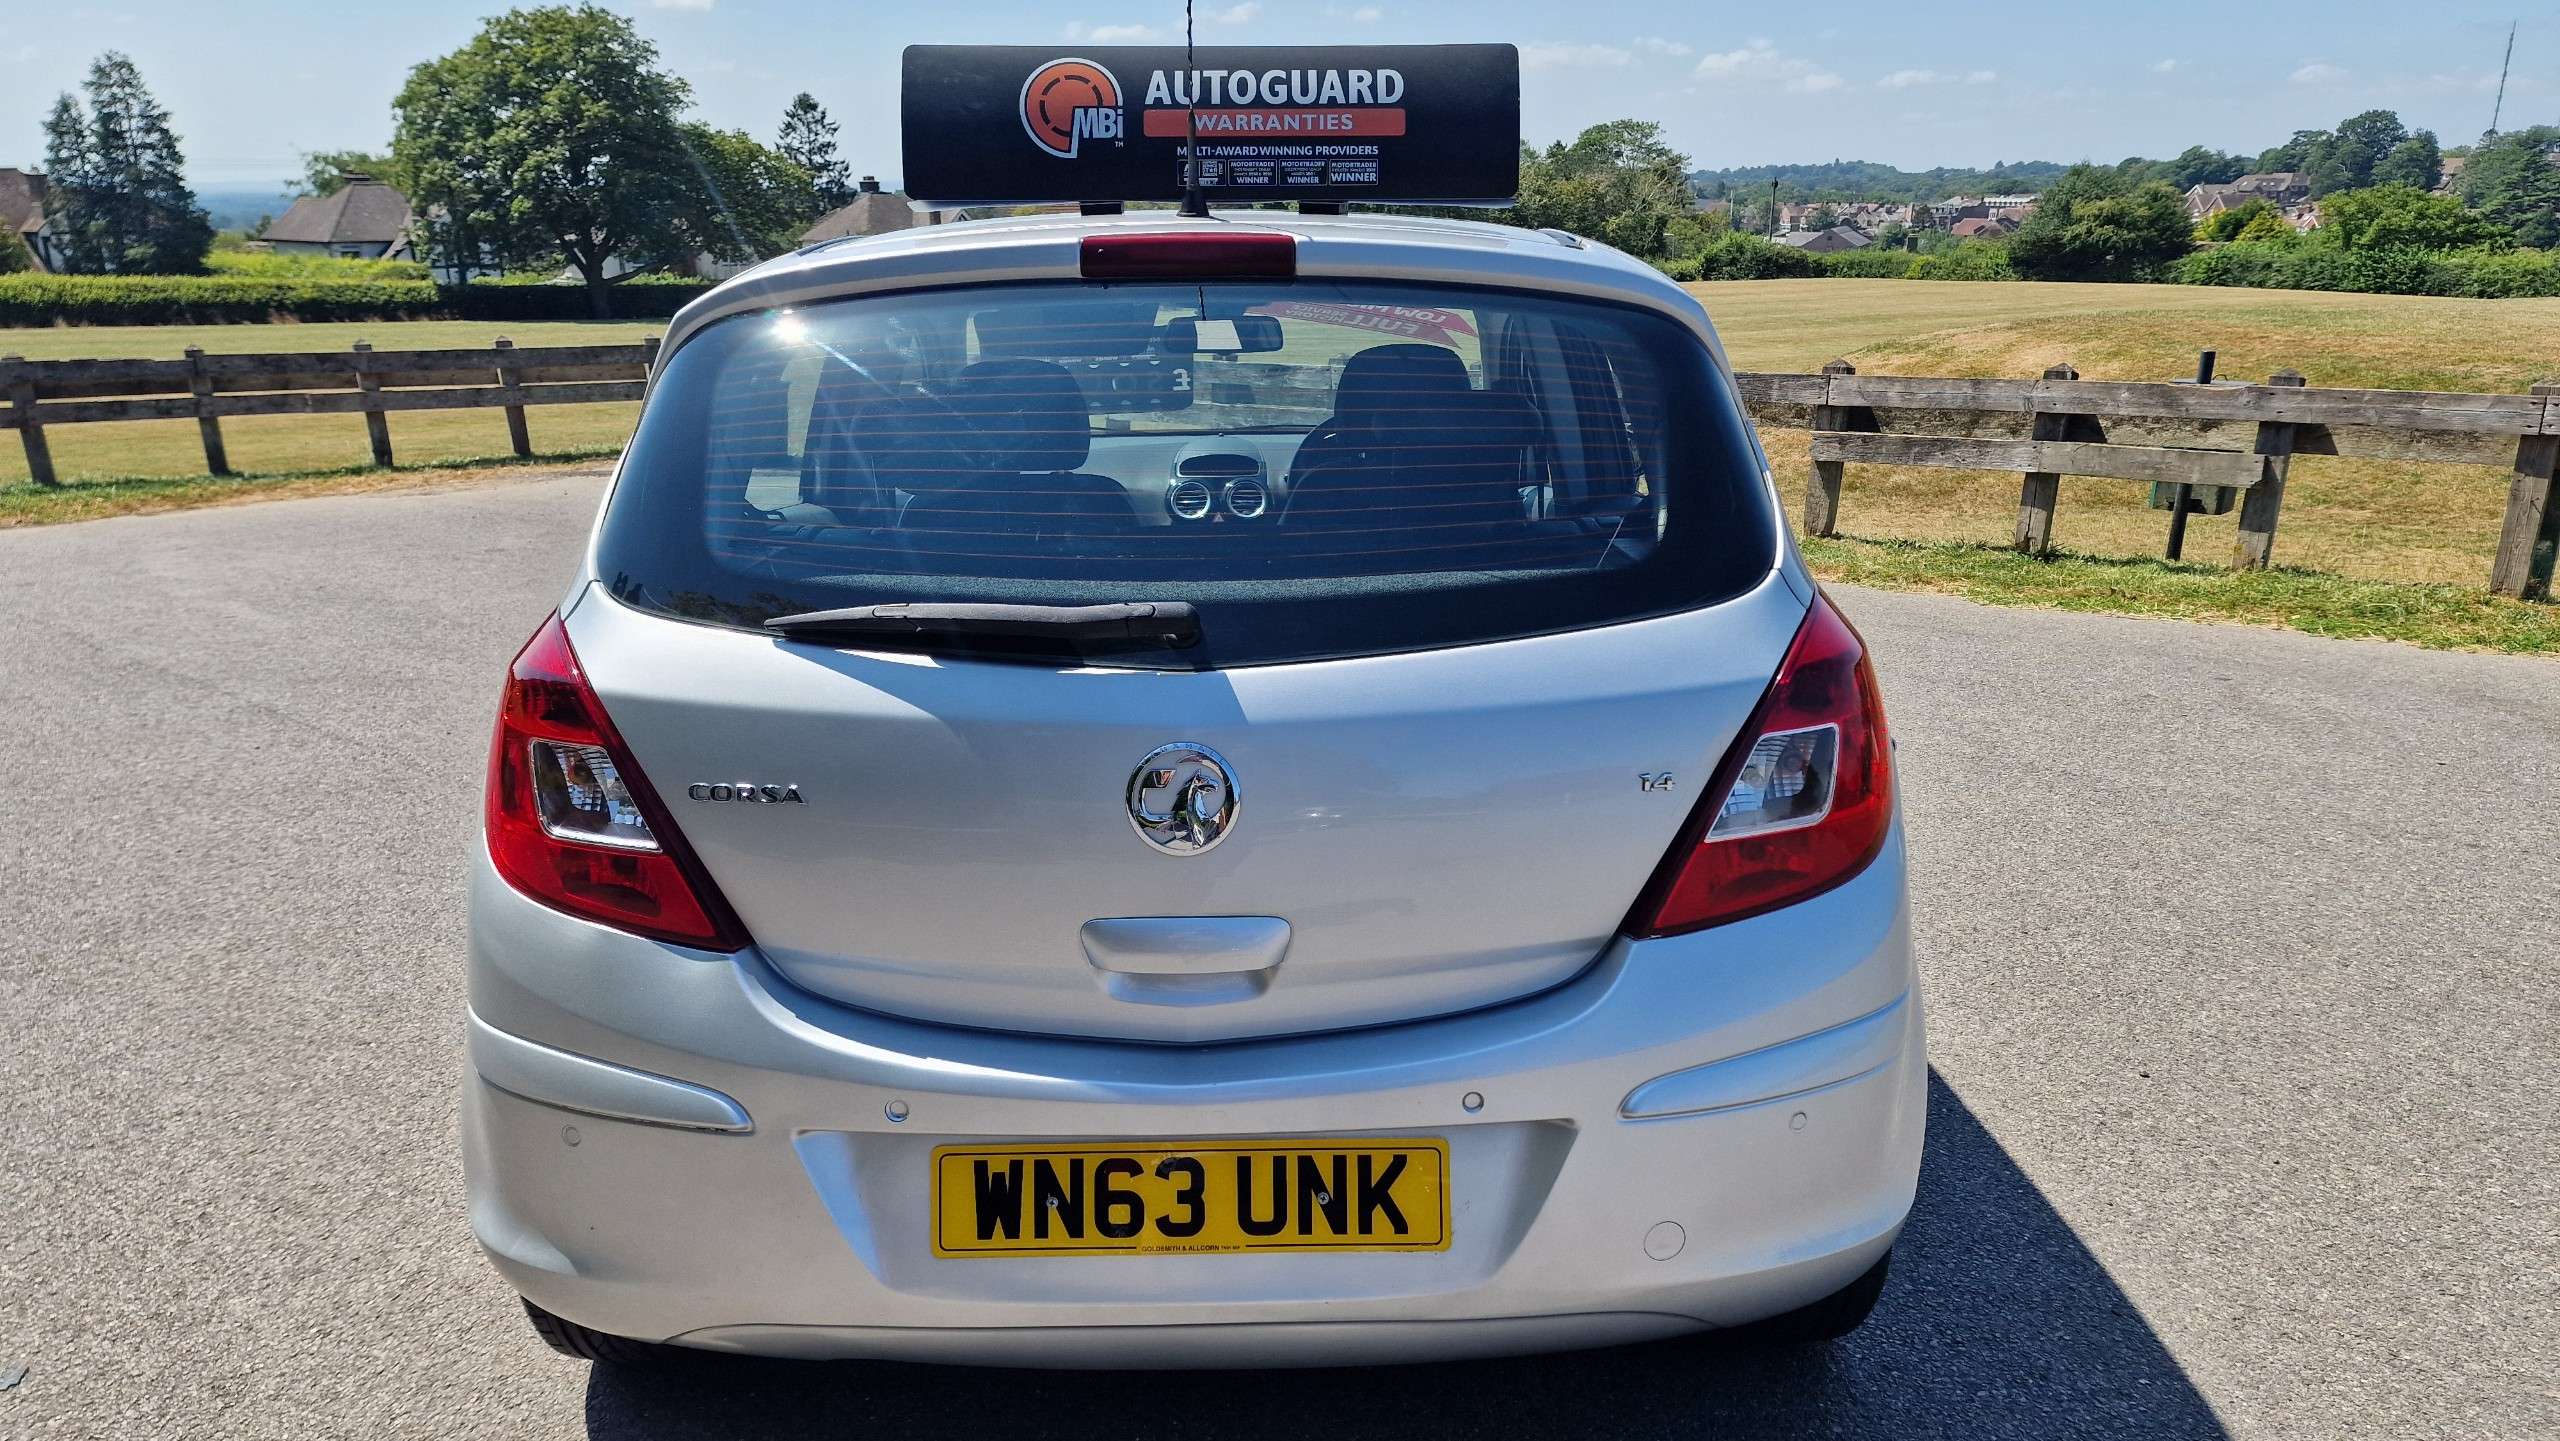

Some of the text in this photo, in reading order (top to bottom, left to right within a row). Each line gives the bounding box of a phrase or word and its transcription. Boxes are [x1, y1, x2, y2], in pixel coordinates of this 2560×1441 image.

[1144, 69, 1404, 105] AUTOGUARD
[1071, 107, 1124, 139] MBi
[1195, 113, 1353, 131] WARRANTIES
[1177, 145, 1379, 156] MLTI-AWARD WINNING PROVIDERS
[1236, 176, 1269, 184] WINNER
[1287, 176, 1319, 184] WINNER
[1331, 172, 1377, 182] WINNER
[688, 782, 805, 804] CORSA
[973, 1154, 1408, 1240] WN63 UNK
